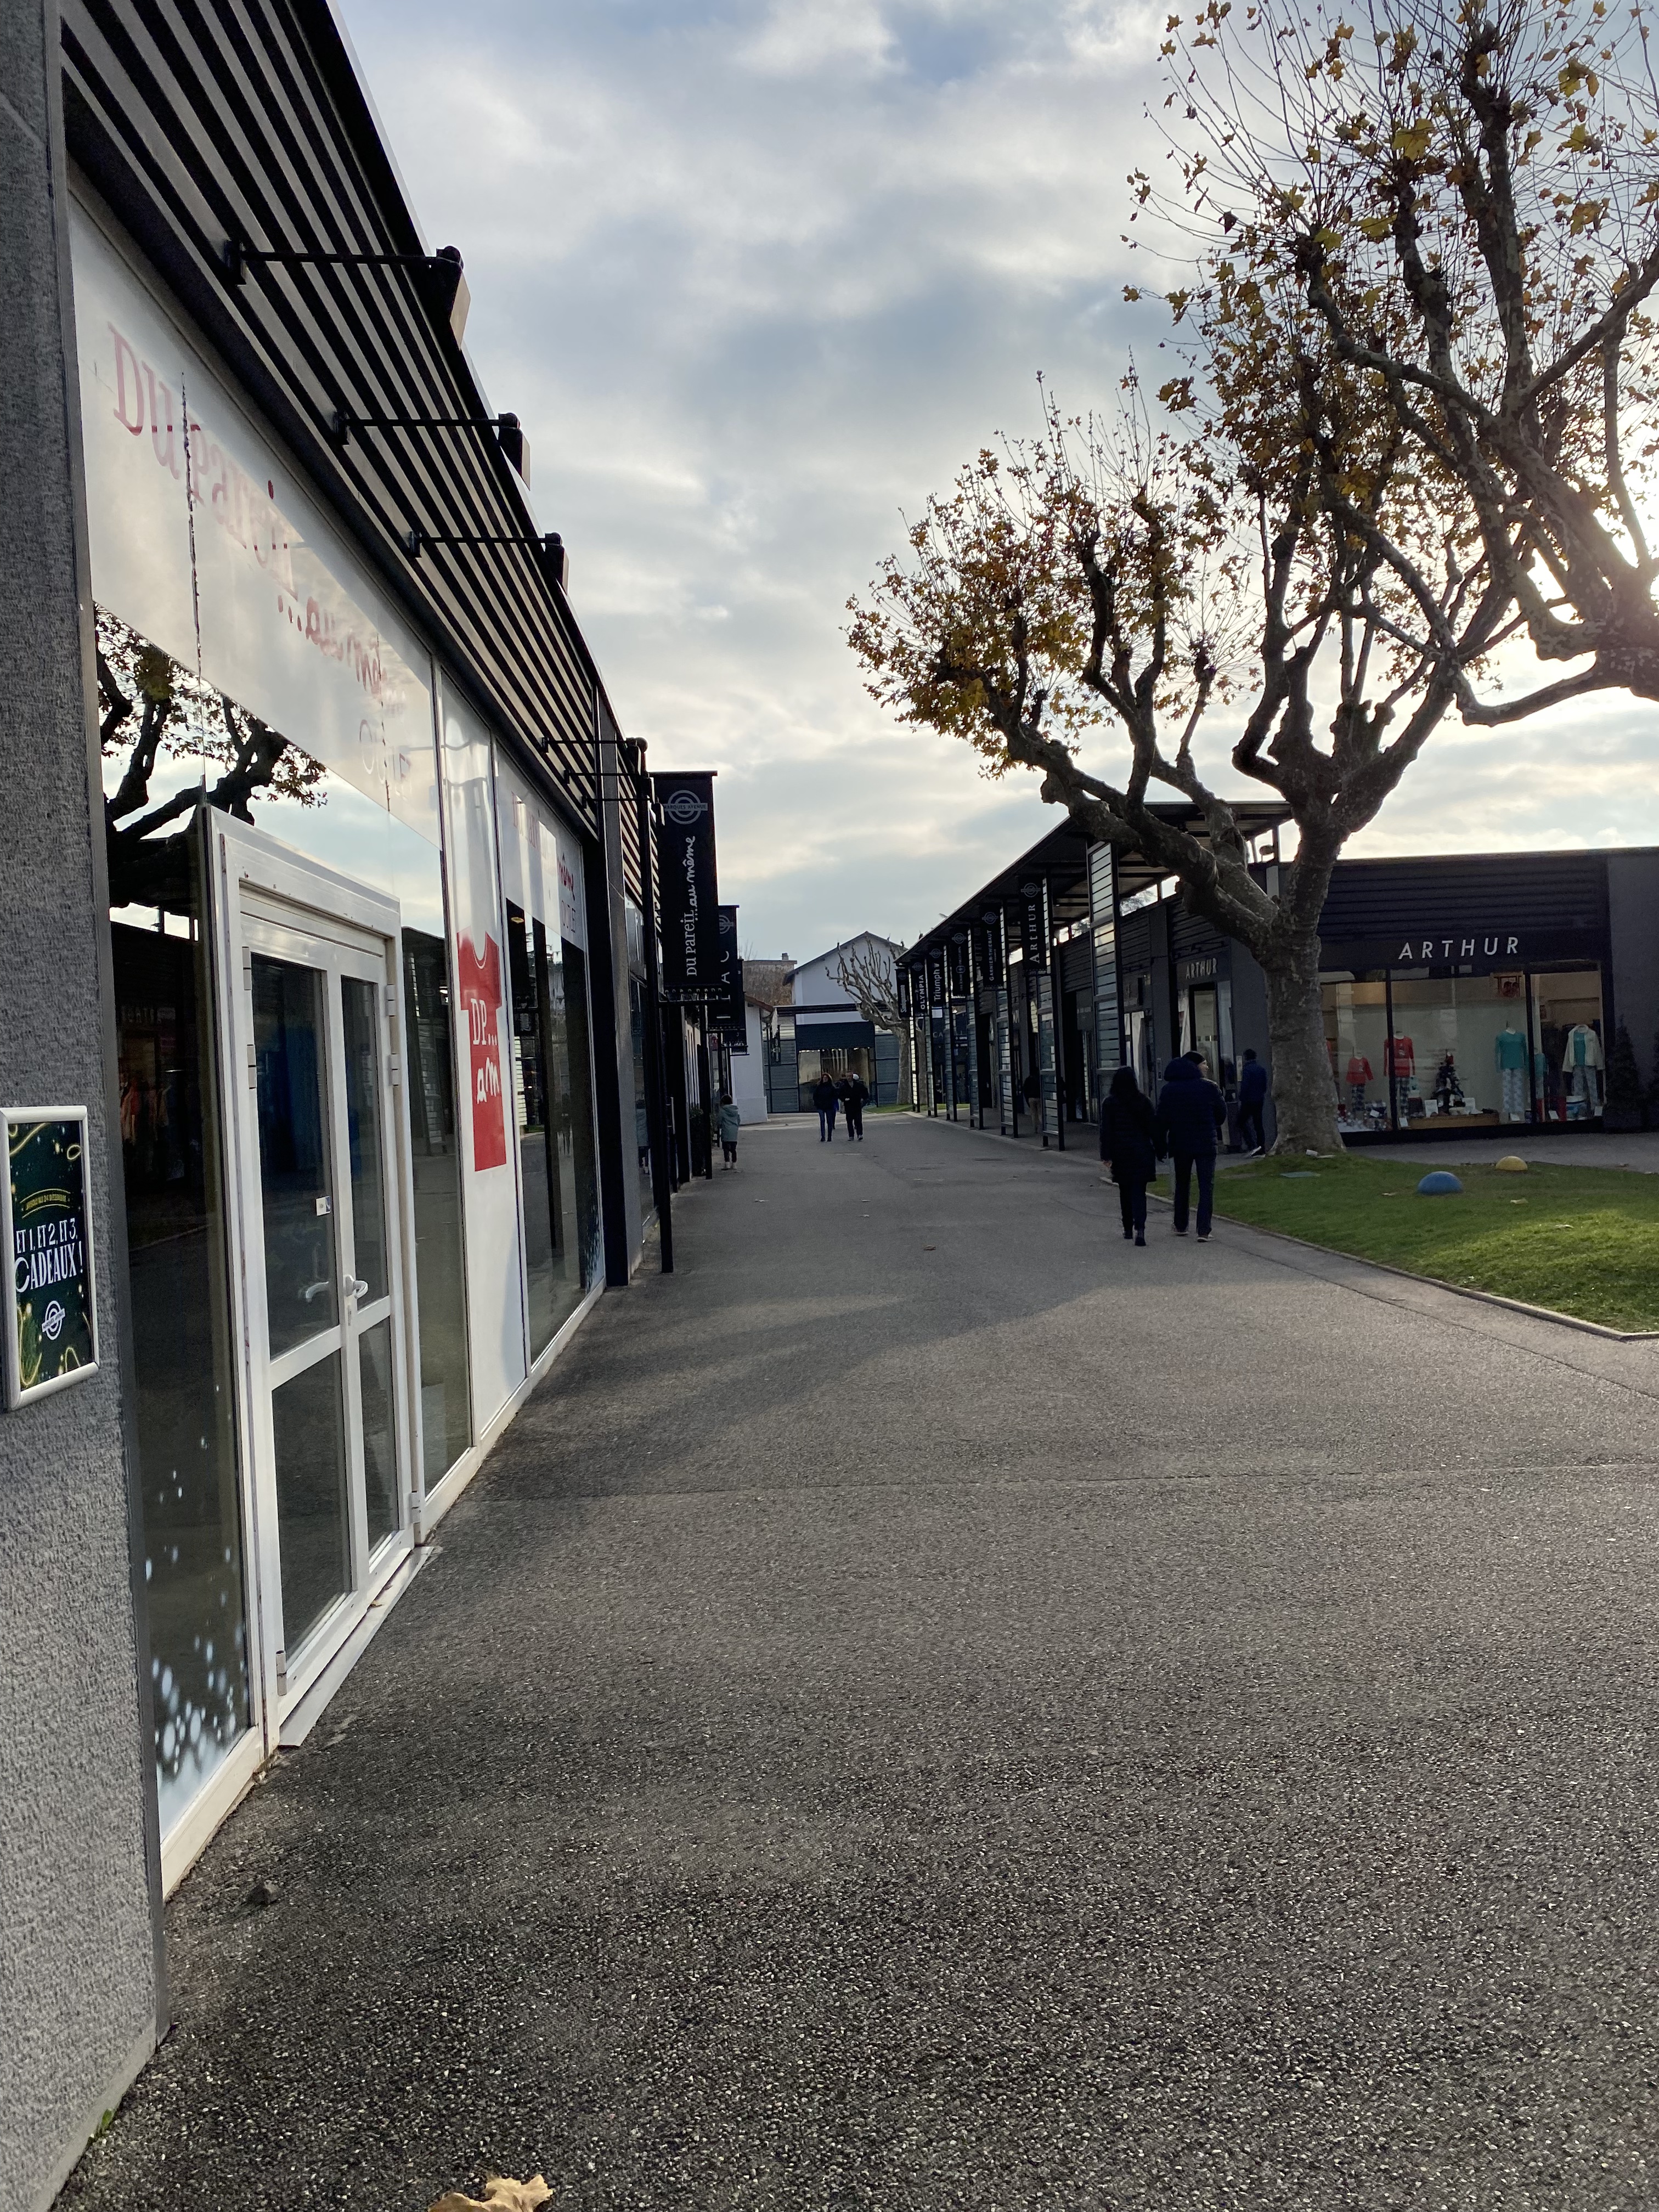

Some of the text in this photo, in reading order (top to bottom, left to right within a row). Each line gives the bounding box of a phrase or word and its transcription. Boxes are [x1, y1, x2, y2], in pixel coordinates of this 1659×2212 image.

[682, 836, 696, 883] même
[1397, 936, 1518, 960] ARTHUR
[933, 969, 942, 1002] Triumph
[1185, 958, 1217, 979] ARTHUR
[919, 975, 927, 1009] OLYMPIA
[16, 1229, 26, 1254] ET
[37, 1224, 46, 1248] ET
[59, 1220, 67, 1242] ET
[14, 1243, 77, 1293] CADEAUX
